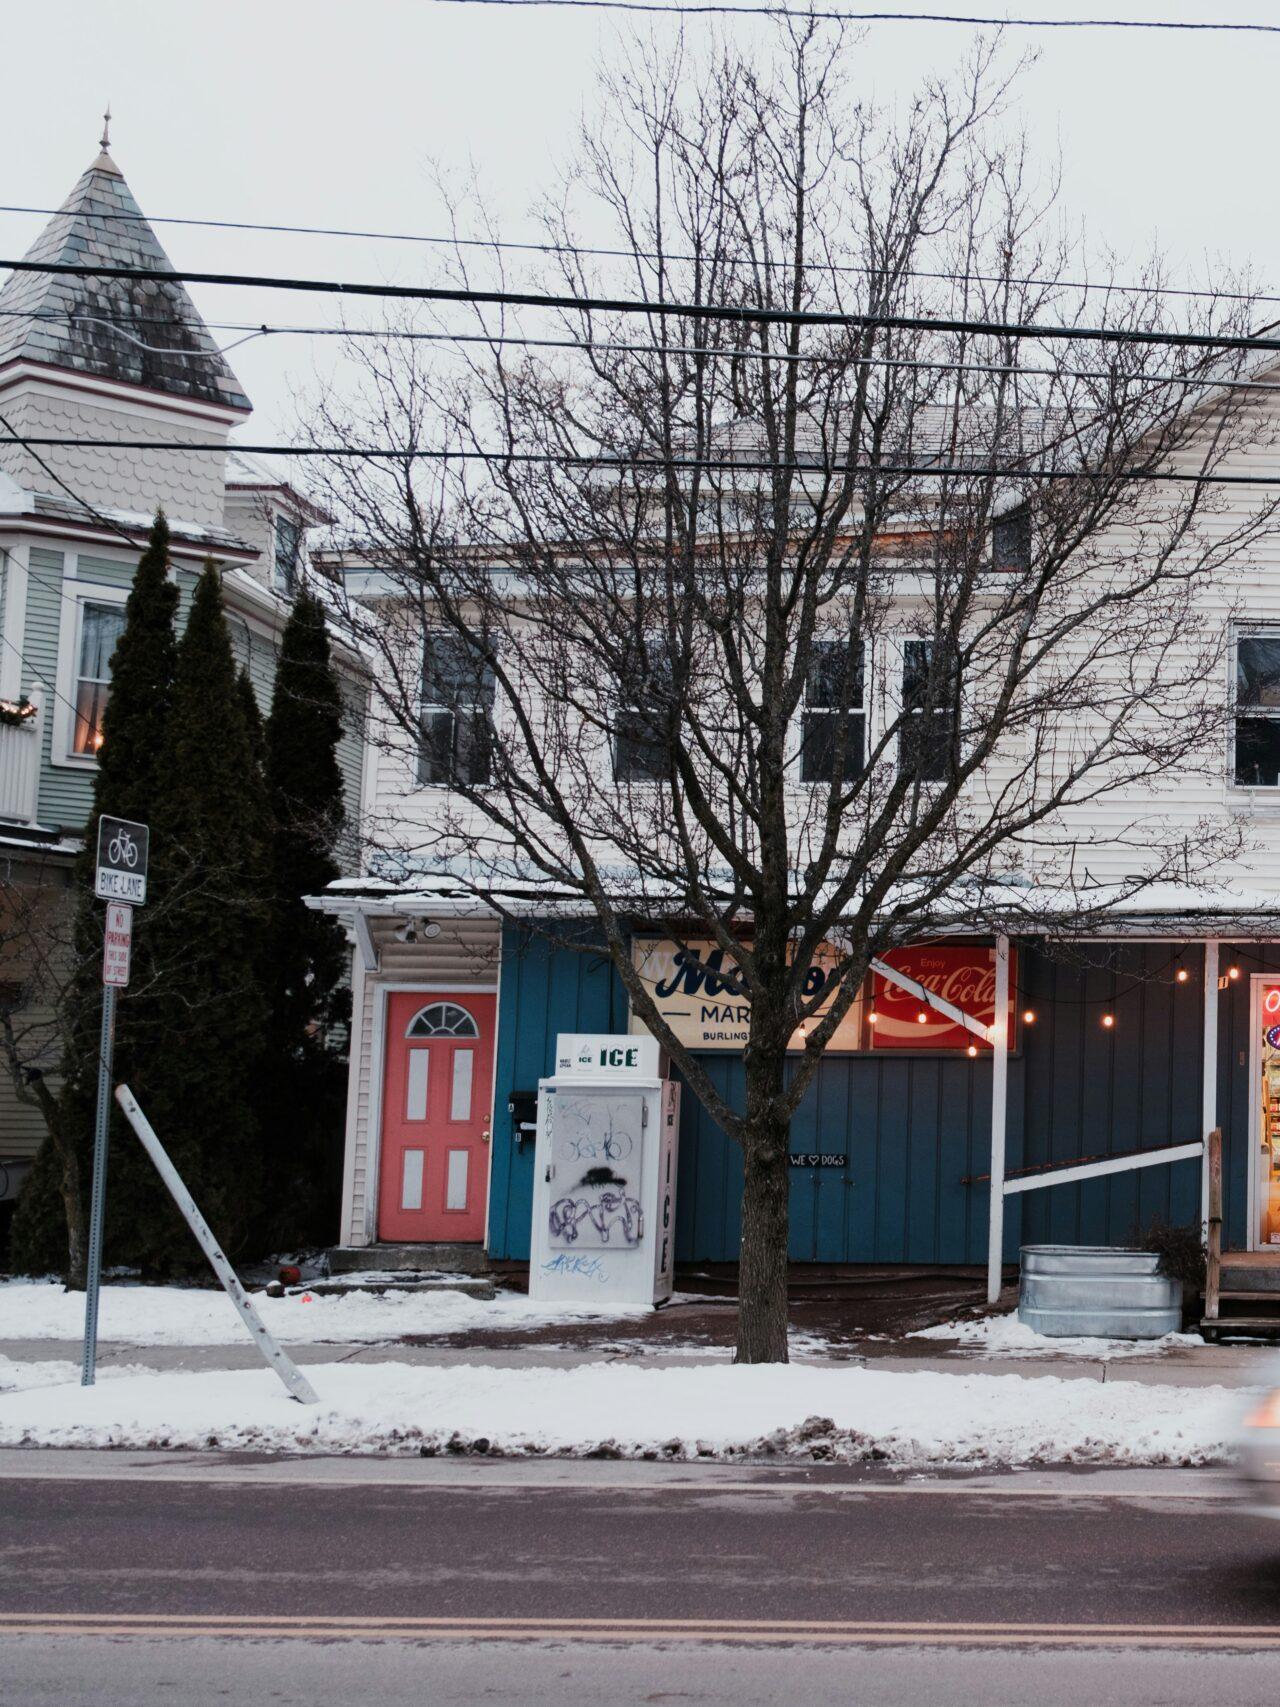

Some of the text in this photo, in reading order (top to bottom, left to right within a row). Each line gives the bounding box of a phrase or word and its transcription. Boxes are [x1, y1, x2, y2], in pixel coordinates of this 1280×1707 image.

[101, 872, 142, 898] BIKE LANE
[115, 913, 124, 928] NO
[107, 931, 130, 948] PARKING
[920, 958, 946, 968] Enjoy
[600, 1048, 639, 1067] ICE
[790, 1155, 844, 1166] WE DOGS
